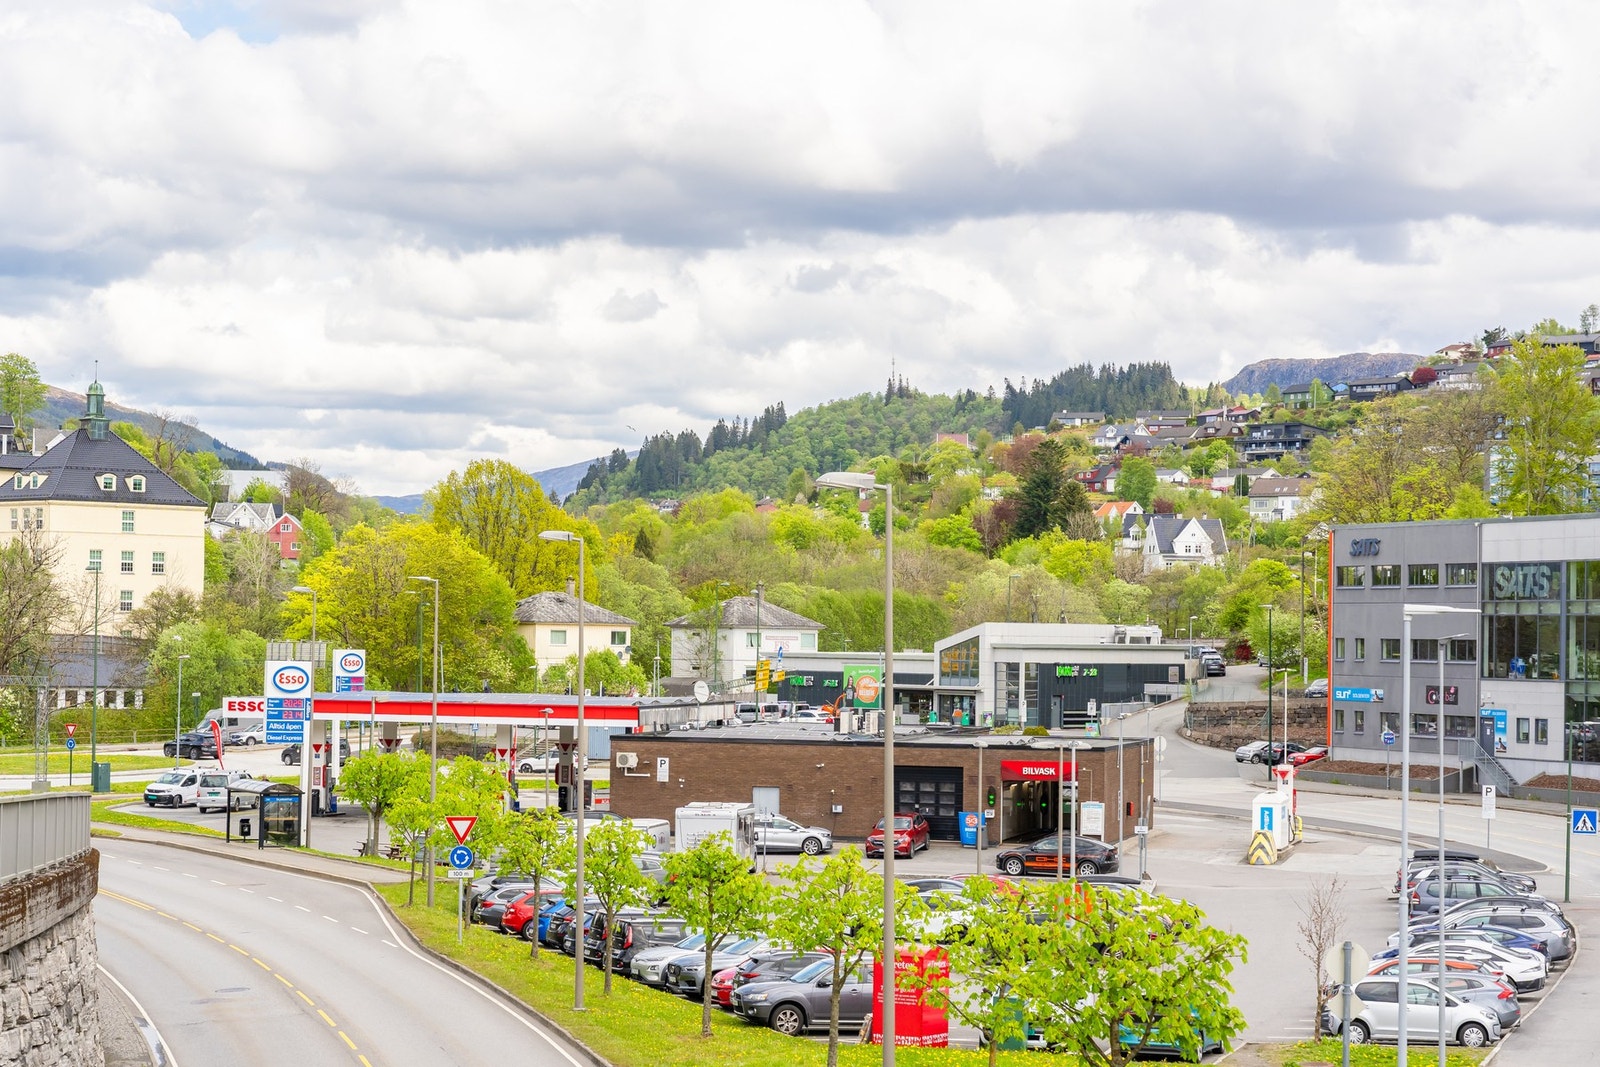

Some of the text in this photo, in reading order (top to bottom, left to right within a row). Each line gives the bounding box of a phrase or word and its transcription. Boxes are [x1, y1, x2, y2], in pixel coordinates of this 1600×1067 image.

[1349, 538, 1381, 556] SATS
[1493, 565, 1552, 598] SATS
[344, 658, 360, 667] Esso
[279, 673, 304, 684] Esso
[269, 722, 302, 731] Alltid åpen
[659, 759, 666, 768] P
[1022, 767, 1056, 776] BILVASK
[1485, 787, 1492, 797] P
